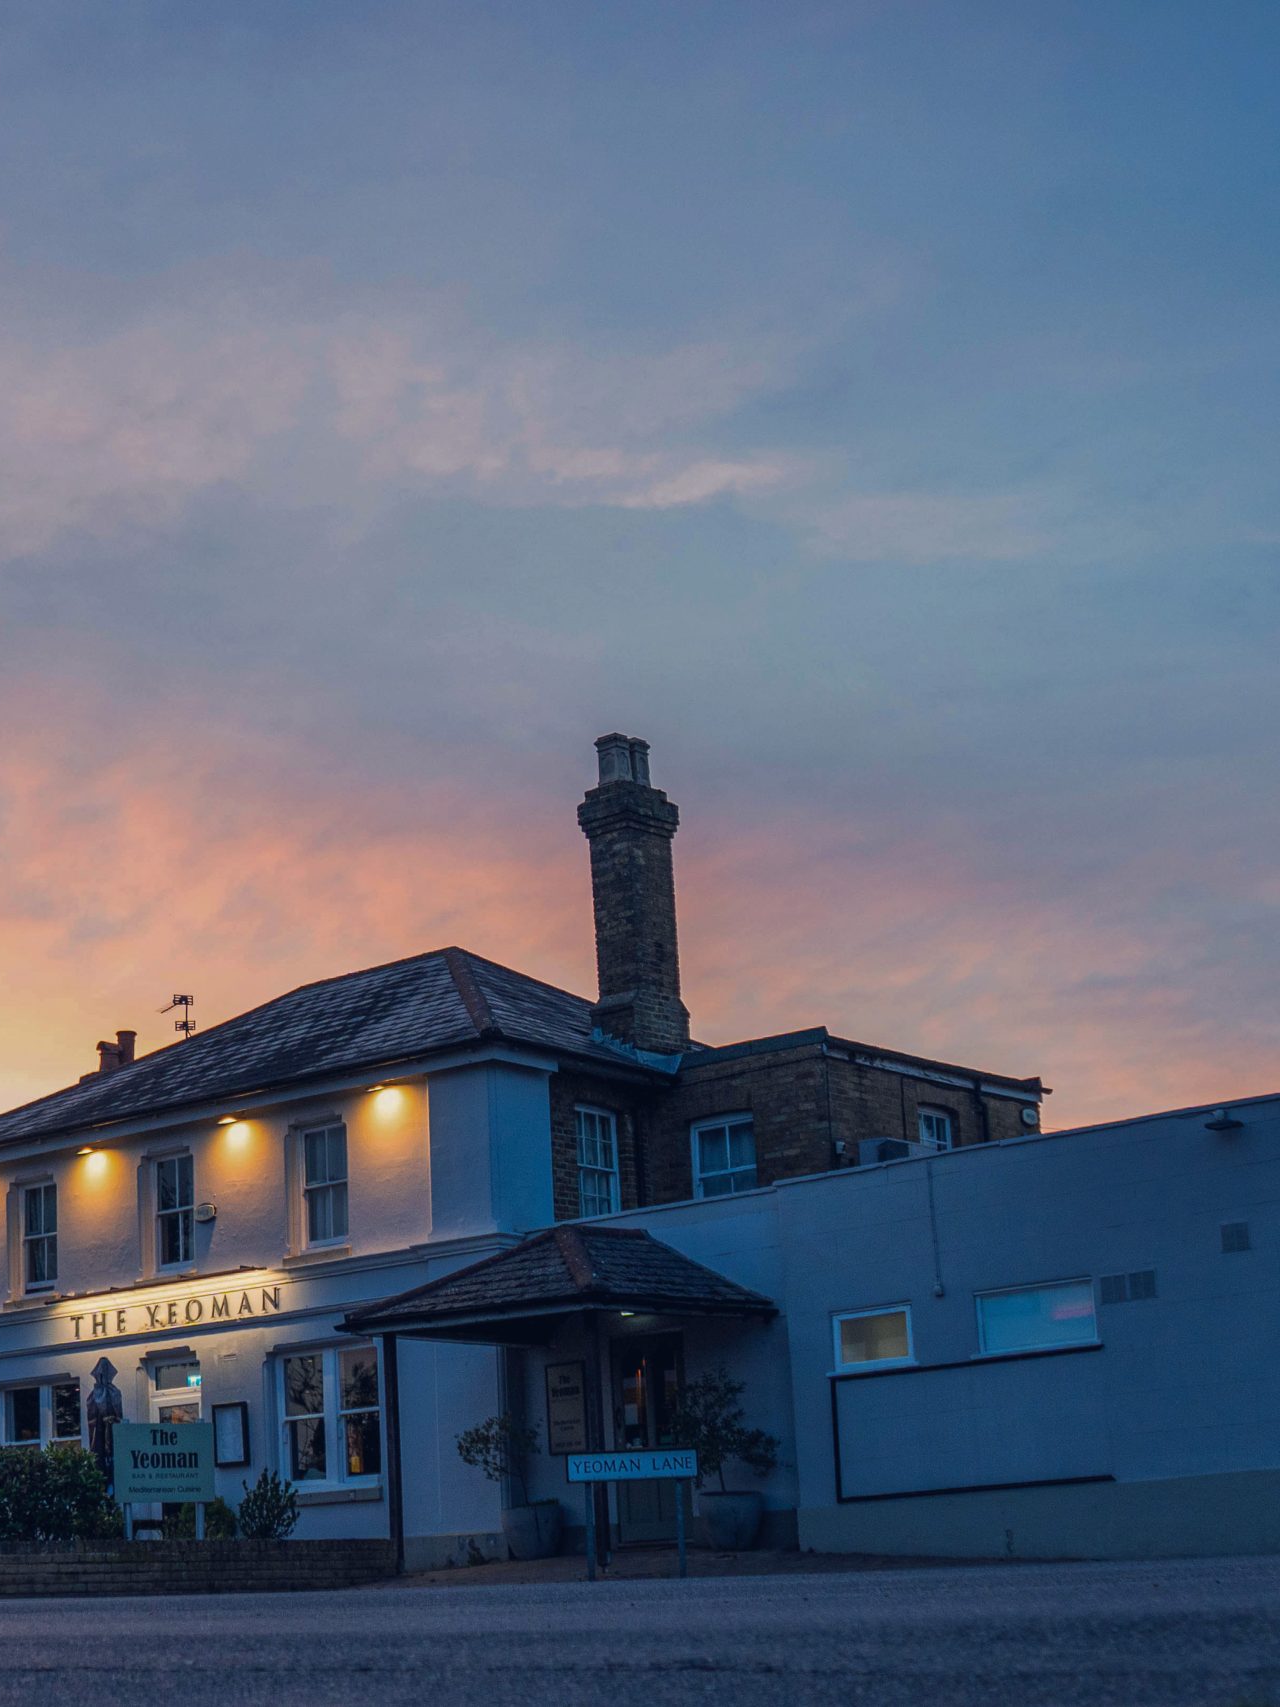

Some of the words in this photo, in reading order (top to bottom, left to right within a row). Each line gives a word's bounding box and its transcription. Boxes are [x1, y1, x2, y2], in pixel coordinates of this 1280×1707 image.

[70, 1309, 126, 1340] THE
[145, 1286, 282, 1330] YEOMAN
[150, 1429, 178, 1446] The
[130, 1450, 199, 1469] Yeoman
[572, 1459, 640, 1474] YEOMAN
[651, 1456, 693, 1471] LANE
[128, 1486, 175, 1495] Mediterranean
